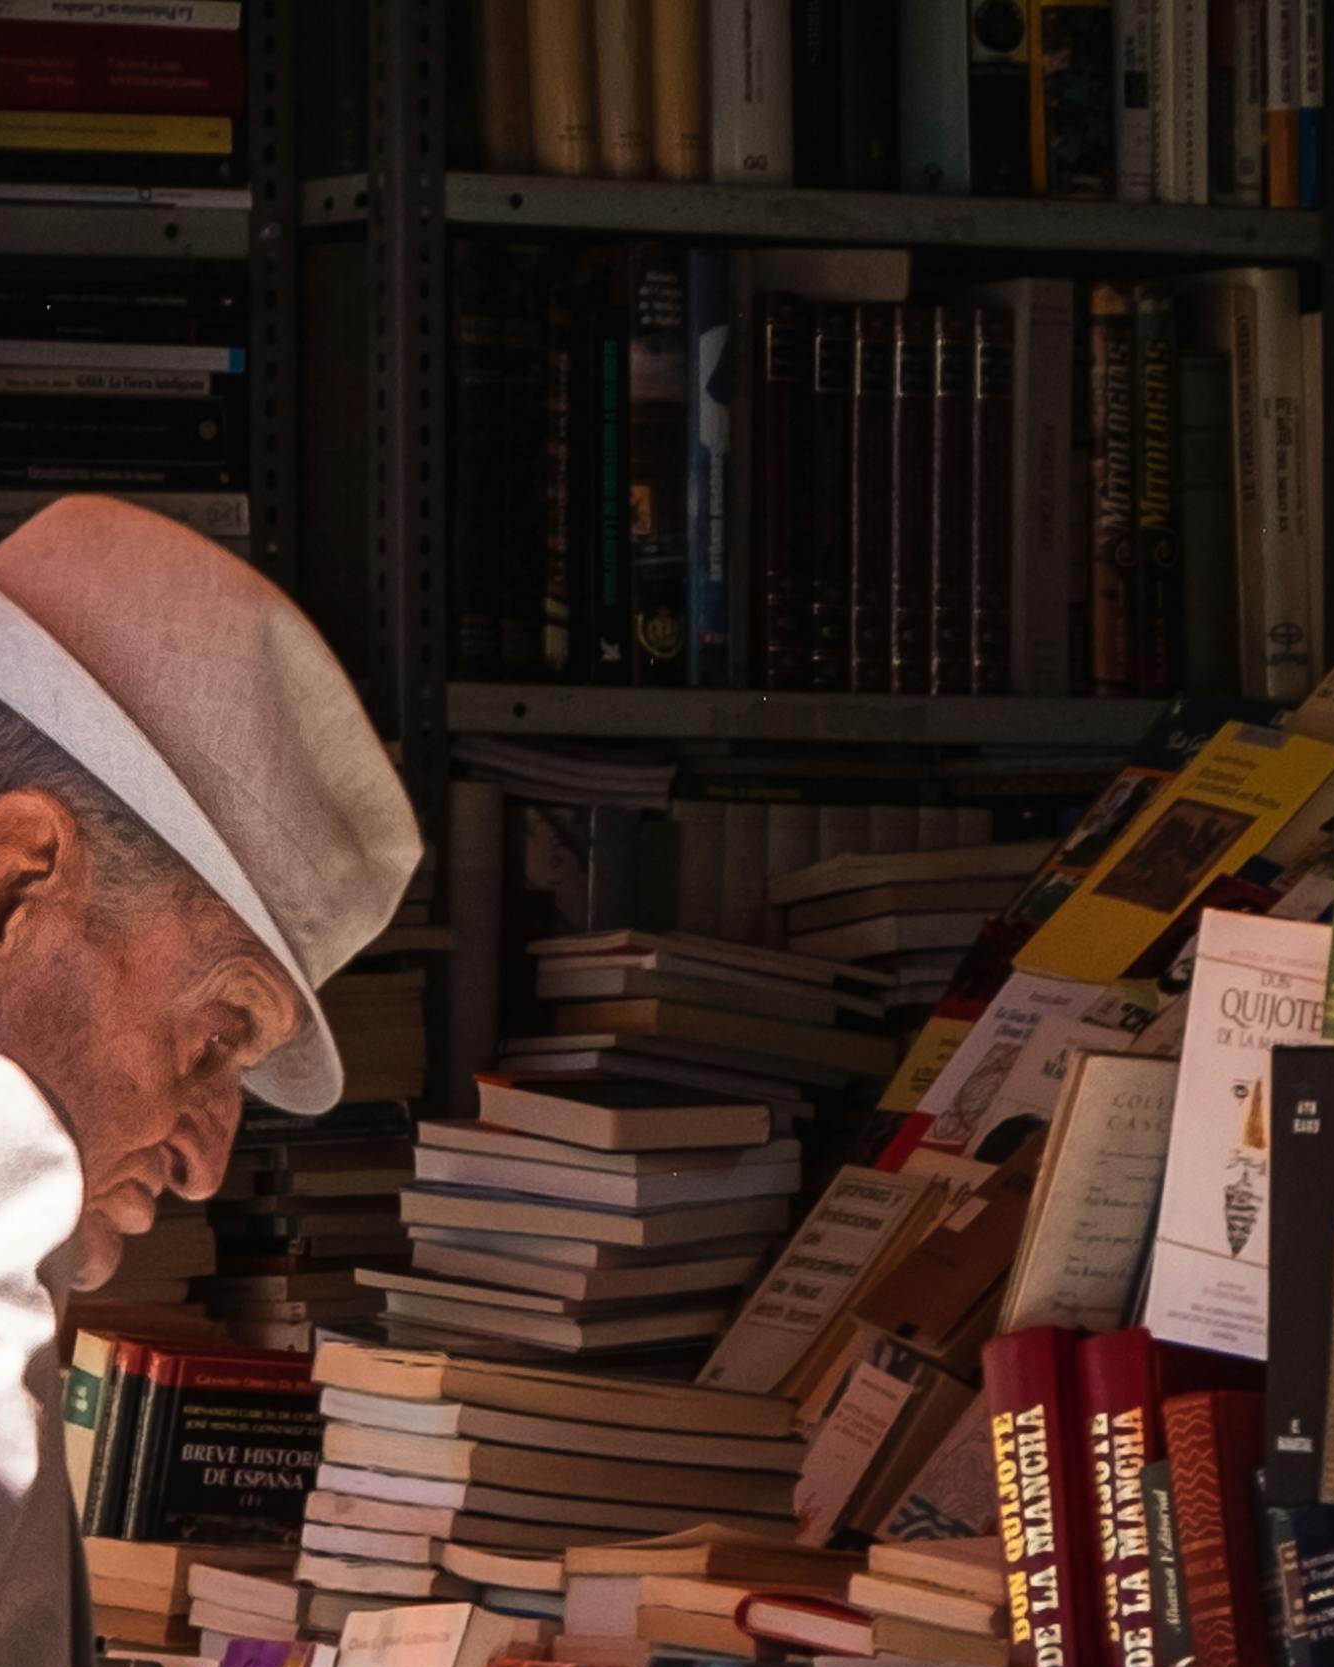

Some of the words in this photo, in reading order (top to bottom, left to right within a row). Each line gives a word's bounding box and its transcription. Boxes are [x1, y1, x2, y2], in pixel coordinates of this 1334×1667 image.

[1220, 987, 1323, 1032] QUIJOTE
[181, 1443, 237, 1465] BREVE
[202, 1469, 230, 1486] DE
[233, 1468, 304, 1490] ESPAÑA
[992, 1411, 1025, 1563] QUIJOTE
[1015, 1403, 1055, 1557] MANCHA
[1111, 1406, 1150, 1560] MANCHA
[1007, 1570, 1032, 1645] DON
[1029, 1564, 1059, 1614] LA
[1119, 1568, 1151, 1617] LA
